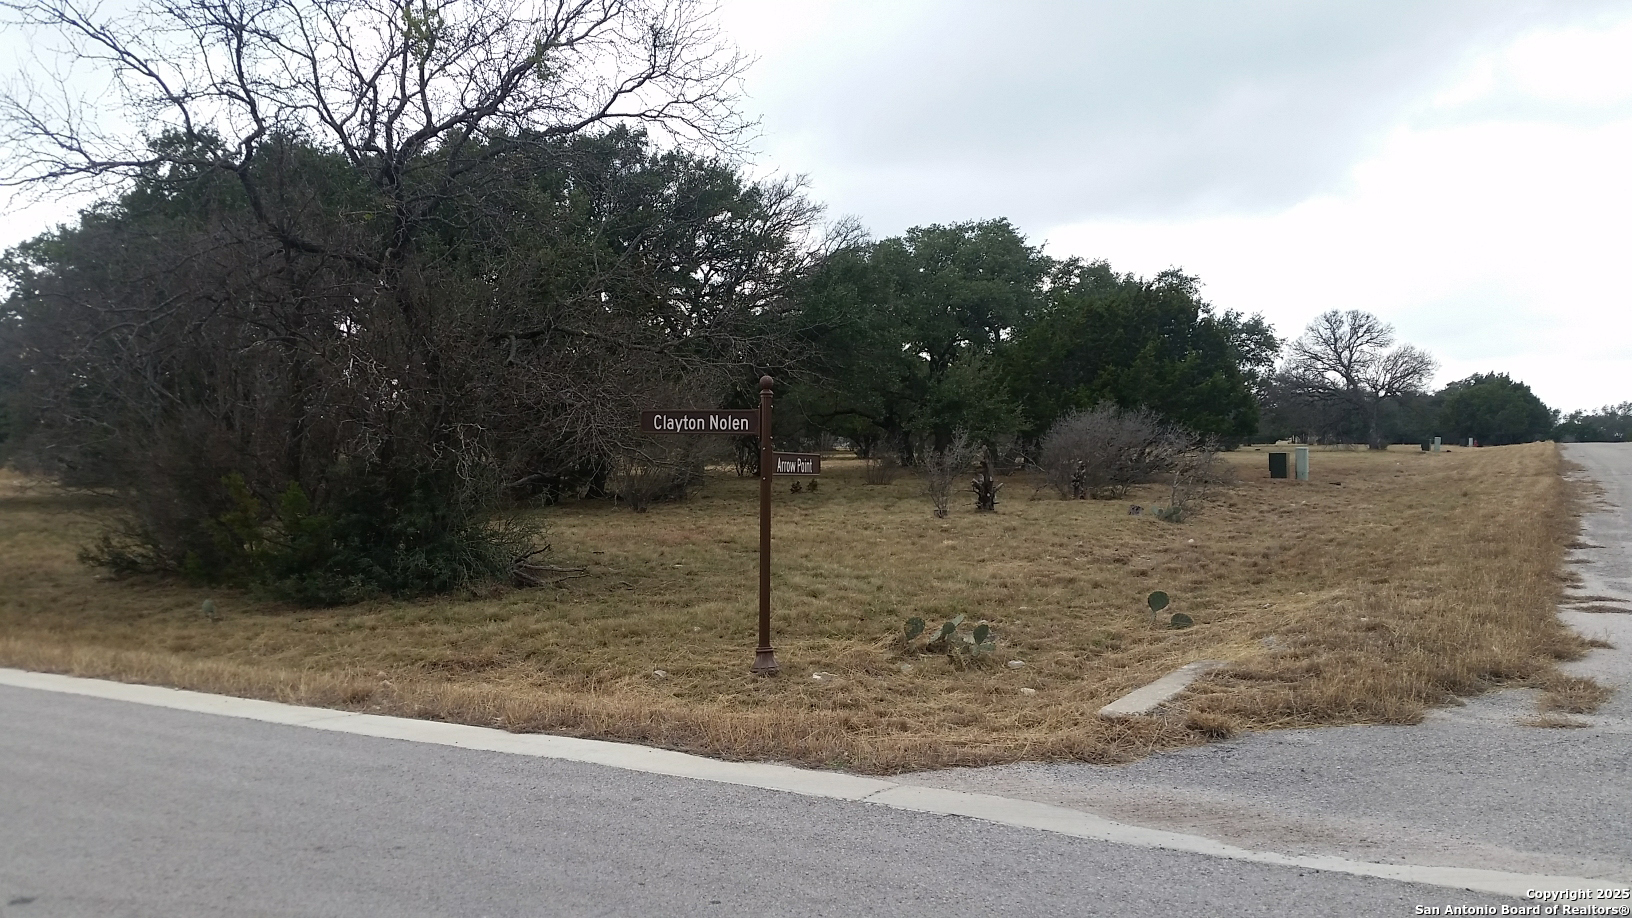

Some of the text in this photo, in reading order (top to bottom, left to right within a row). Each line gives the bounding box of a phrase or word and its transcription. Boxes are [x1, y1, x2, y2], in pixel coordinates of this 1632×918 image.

[653, 414, 749, 433] Clayton Nolen
[776, 457, 813, 473] Arrow Point
